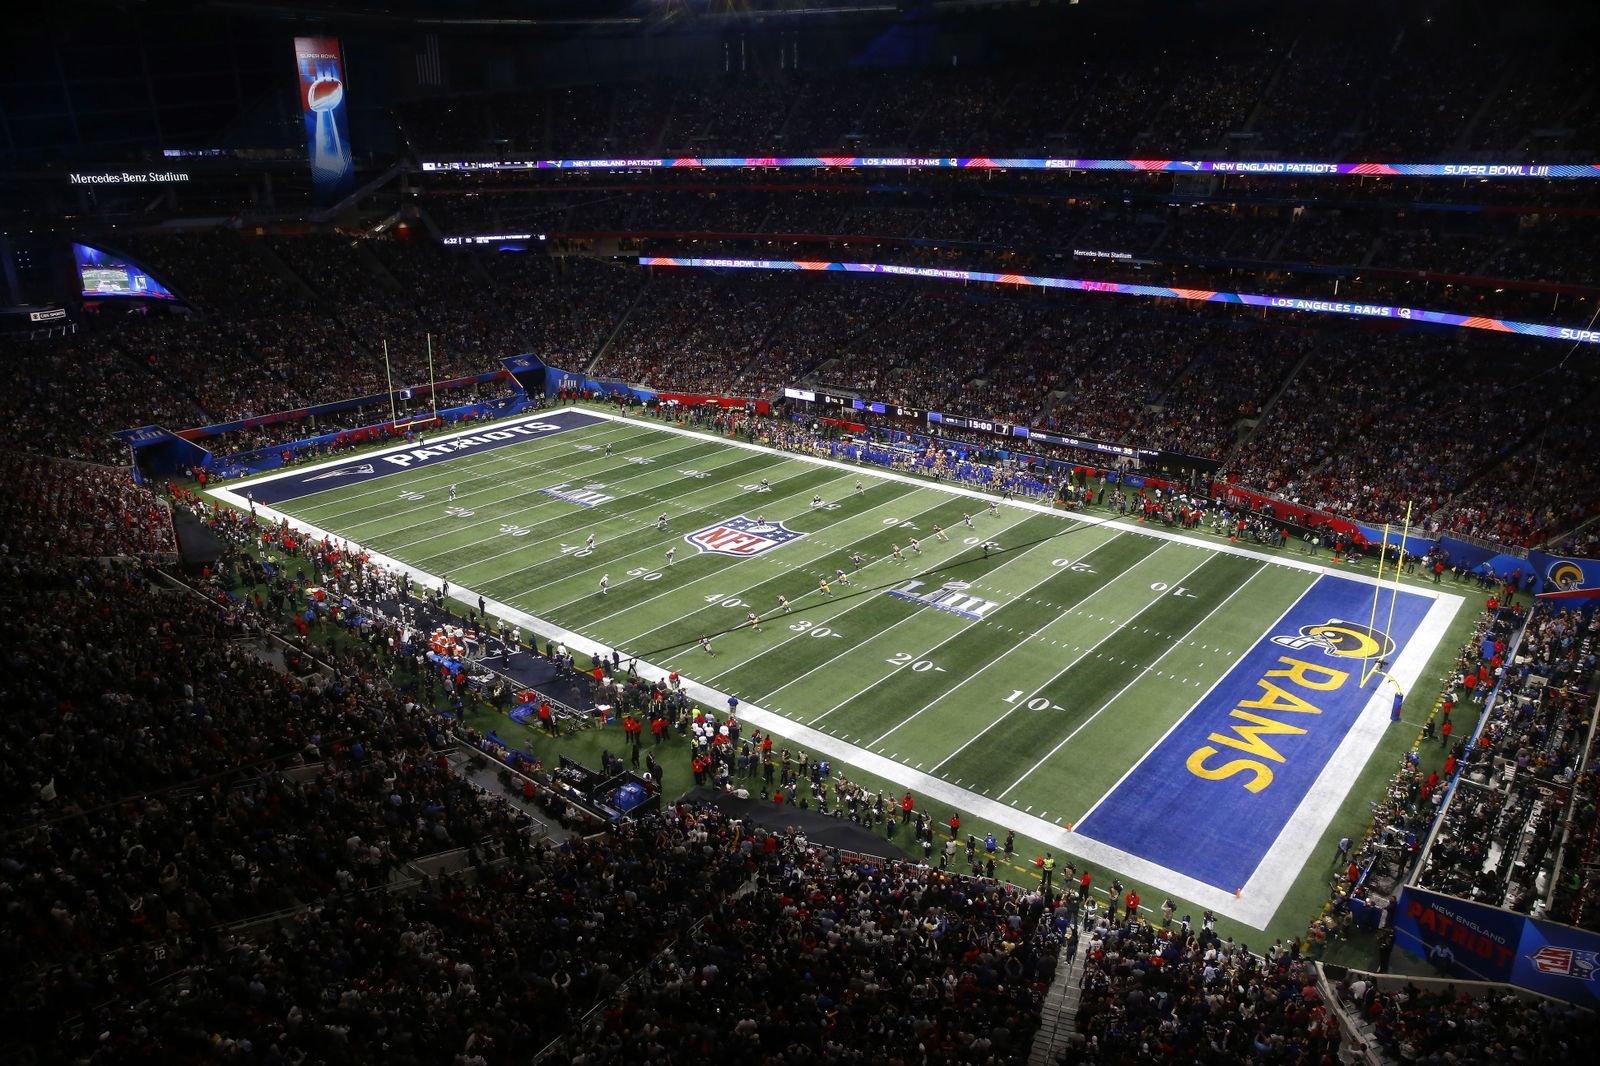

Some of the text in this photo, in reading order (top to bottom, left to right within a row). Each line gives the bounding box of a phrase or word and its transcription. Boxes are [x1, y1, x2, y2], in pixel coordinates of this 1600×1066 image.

[862, 158, 940, 166] LOS ANGELES RAMS
[1045, 160, 1076, 168] #SBLIII
[1212, 163, 1338, 173] NEW ENGLAND PATRIOTS
[1443, 165, 1549, 176] SUPER BOWL LIII
[70, 172, 189, 184] Mercedes-Benz Stadium
[1073, 249, 1110, 258] Mercedes-Benz
[734, 260, 757, 268] BOWL
[882, 265, 970, 279] NEW ENGLAND PATRIOTS
[1271, 298, 1389, 316] LOS ANGELES RAMS
[968, 420, 992, 431] 15:00
[1002, 425, 1007, 434] 7
[381, 421, 562, 467] PATRIOTS
[1097, 444, 1111, 452] BALL
[499, 525, 531, 536] 30
[697, 527, 767, 554] NFL
[1051, 558, 1091, 572] 20
[626, 567, 663, 581] 50
[1150, 582, 1190, 597] 10
[703, 593, 742, 608] 40
[889, 579, 1000, 619] LIII
[789, 620, 832, 638] 30
[885, 652, 934, 672] 20
[1001, 689, 1050, 711] 10
[1186, 656, 1350, 793] RAMS
[1431, 902, 1506, 945] NEW ENGLAND
[154, 949, 166, 960] 12
